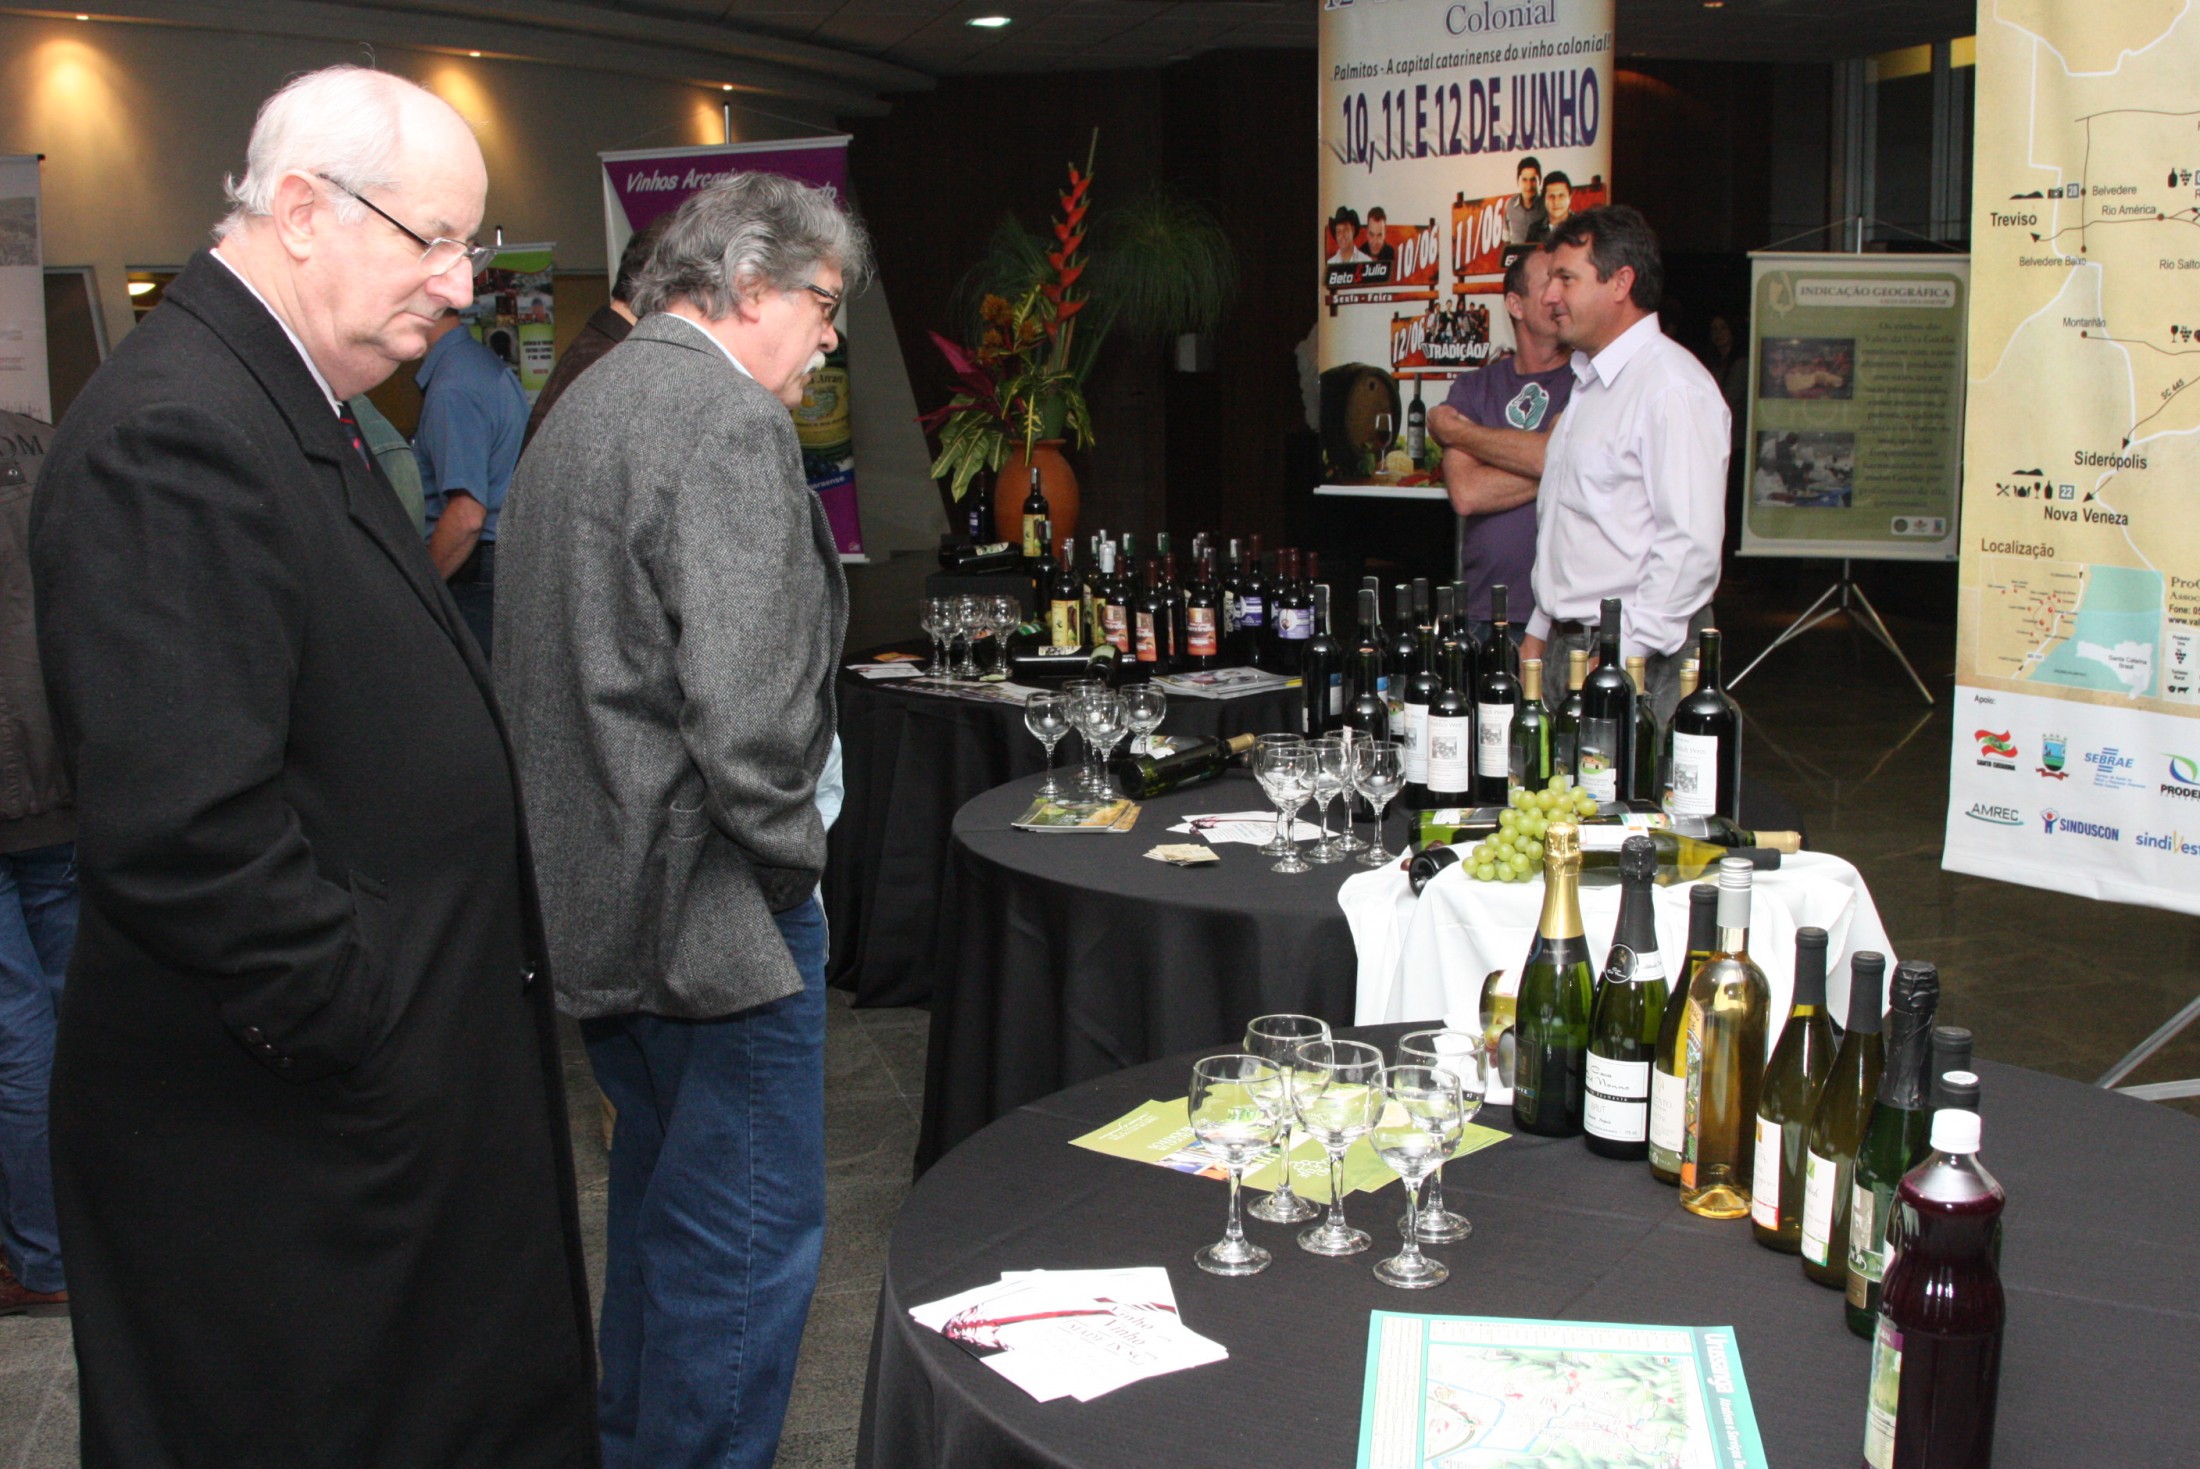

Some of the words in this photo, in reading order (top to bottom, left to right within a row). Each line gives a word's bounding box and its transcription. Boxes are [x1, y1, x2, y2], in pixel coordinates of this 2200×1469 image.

[1446, 0, 1557, 35] Colonial
[1334, 59, 1378, 80] Palmitos
[1386, 58, 1394, 73] A
[1396, 53, 1434, 76] capital
[1436, 47, 1501, 69] catarinense
[1504, 43, 1518, 62] do
[1521, 39, 1554, 60] vinho
[1557, 32, 1611, 55] colonial!
[1382, 89, 1405, 159] 11
[1416, 84, 1427, 157] E
[1435, 82, 1462, 156] 12
[1470, 77, 1501, 154] DE
[1507, 67, 1599, 152] JUNHO
[627, 170, 678, 193] Vinhos
[2092, 185, 2137, 197] Belvedere
[1990, 212, 2037, 226] Treviso
[2102, 205, 2117, 216] Rio
[2119, 204, 2156, 215] América
[1455, 198, 1504, 270] 11/06
[1396, 225, 1438, 281] 10/06
[2019, 256, 2063, 267] Belvedere
[2064, 256, 2086, 267] Baixo
[1329, 271, 1353, 285] Beto
[1362, 263, 1387, 277] Julio
[2159, 260, 2175, 270] Rio
[1367, 292, 1393, 303] Feira
[1801, 285, 1870, 298] INDICAÇÃO
[1872, 286, 1950, 297] GEOGRÁFICA
[2063, 317, 2106, 328] Montanhão
[1393, 318, 1425, 362] 12/06
[1428, 337, 1484, 362] TRADIÇÃO
[2161, 388, 2172, 400] SC
[2074, 451, 2148, 470] Siderópolis
[2060, 486, 2074, 499] 22
[2044, 506, 2078, 522] Nova
[2082, 508, 2129, 525] Veneza
[1981, 538, 2055, 557] Localização
[2169, 604, 2191, 614] Fone:
[1974, 695, 1995, 704] Apoio:
[2084, 752, 2134, 769] SEBRAE
[1971, 803, 2019, 821] AMREC
[2060, 819, 2119, 841] SINDUSCON
[1591, 1102, 1606, 1113] BRUT
[1110, 1304, 1154, 1330] Vinho
[1103, 1319, 1146, 1345] Vinho
[1704, 1333, 1734, 1393] Urussanga
[1726, 1431, 1742, 1459] Serviços
